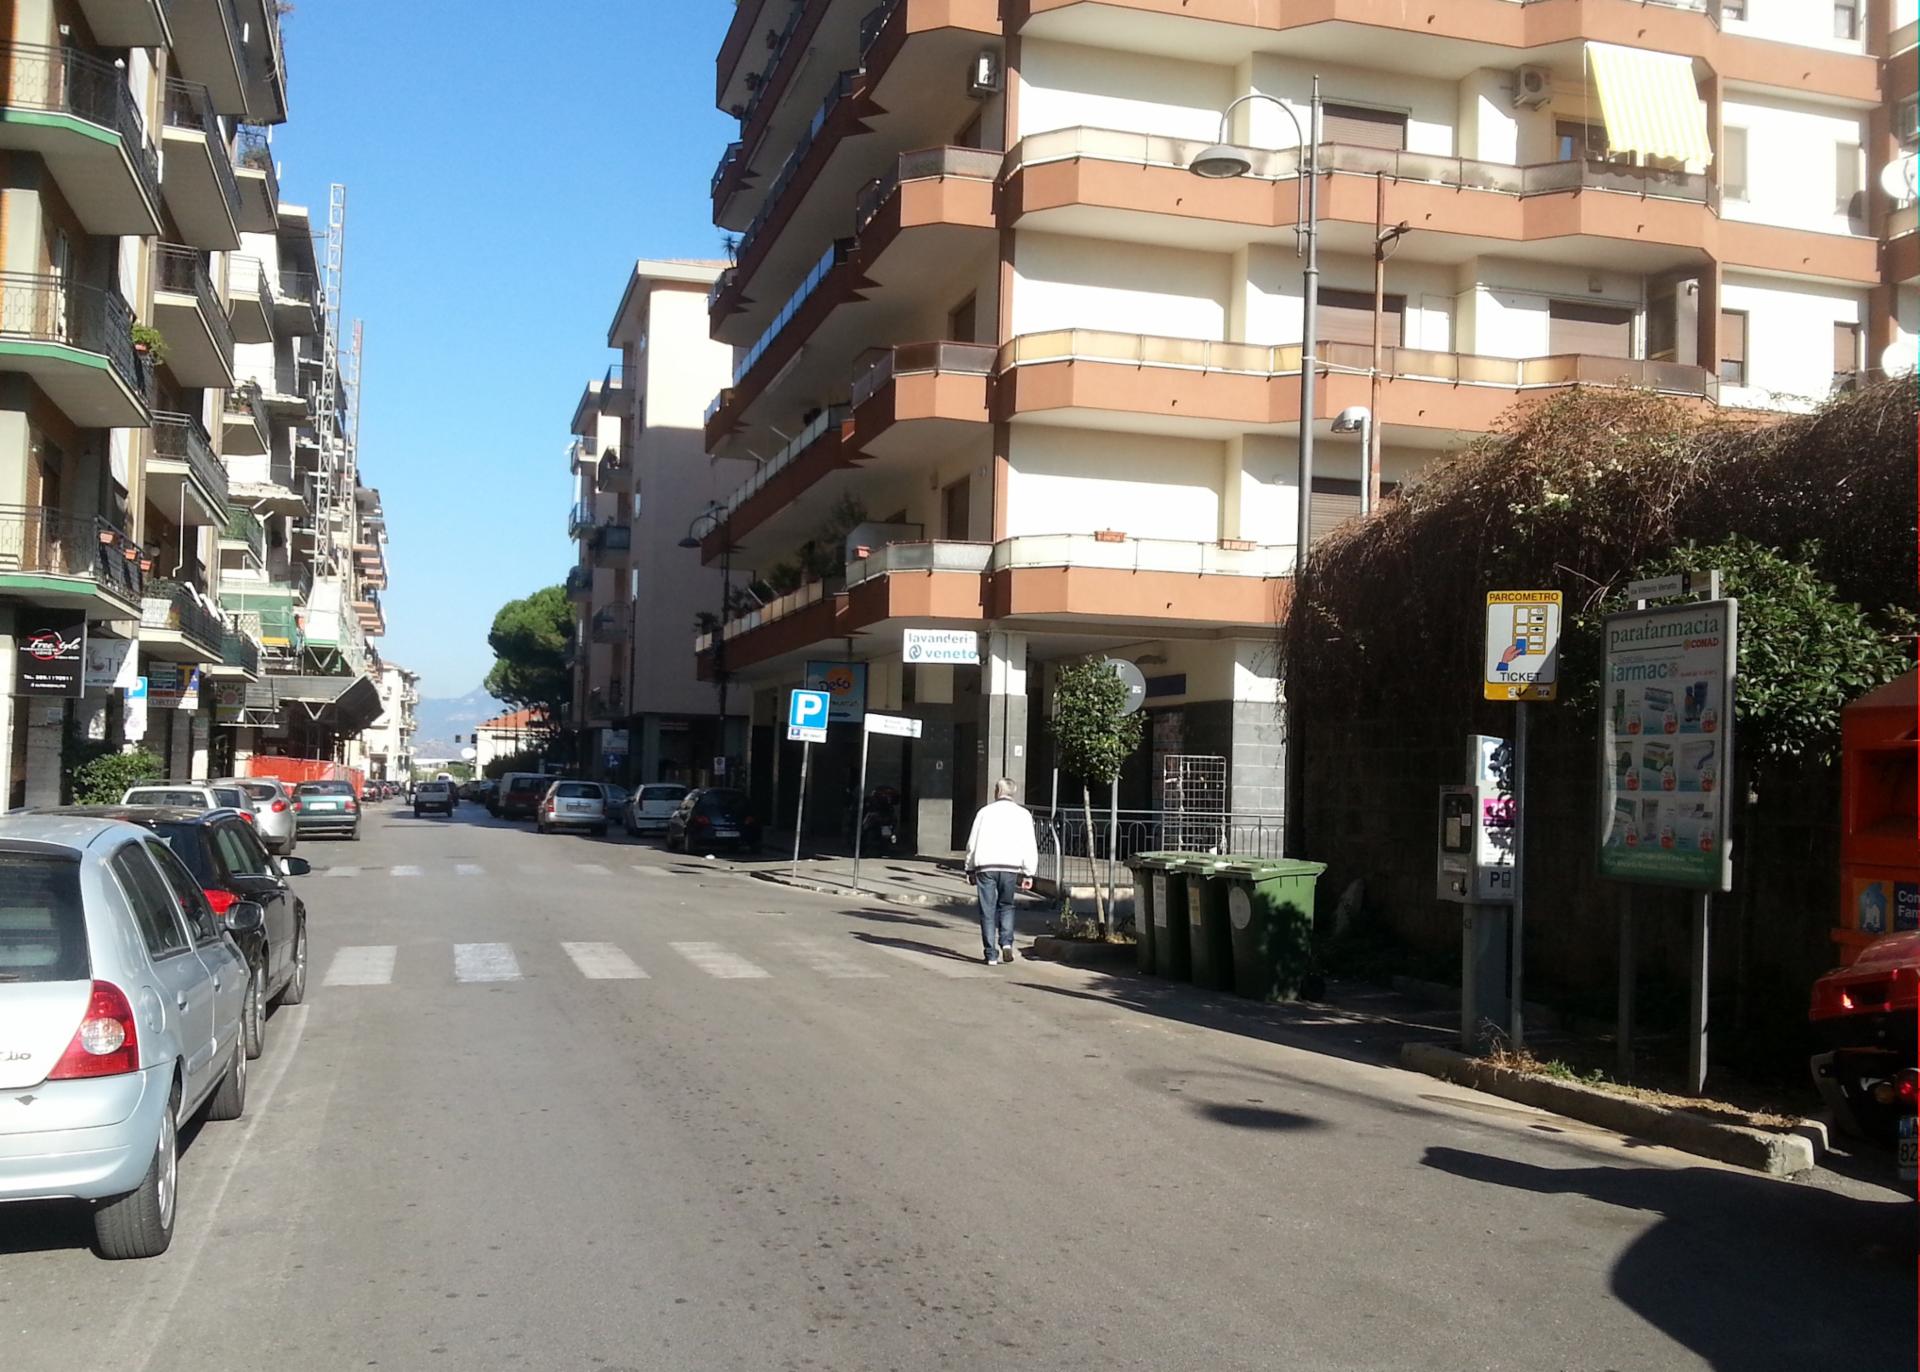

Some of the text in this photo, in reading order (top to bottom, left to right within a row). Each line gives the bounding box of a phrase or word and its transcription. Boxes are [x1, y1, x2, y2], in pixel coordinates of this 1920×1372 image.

[1489, 592, 1559, 601] PARCOMETRO
[1610, 612, 1719, 651] parafarmacia
[908, 633, 975, 644] lavanderi
[1691, 639, 1720, 649] CONAD
[925, 649, 977, 659] veneto
[1500, 671, 1542, 682] TICKET
[796, 693, 823, 725] P
